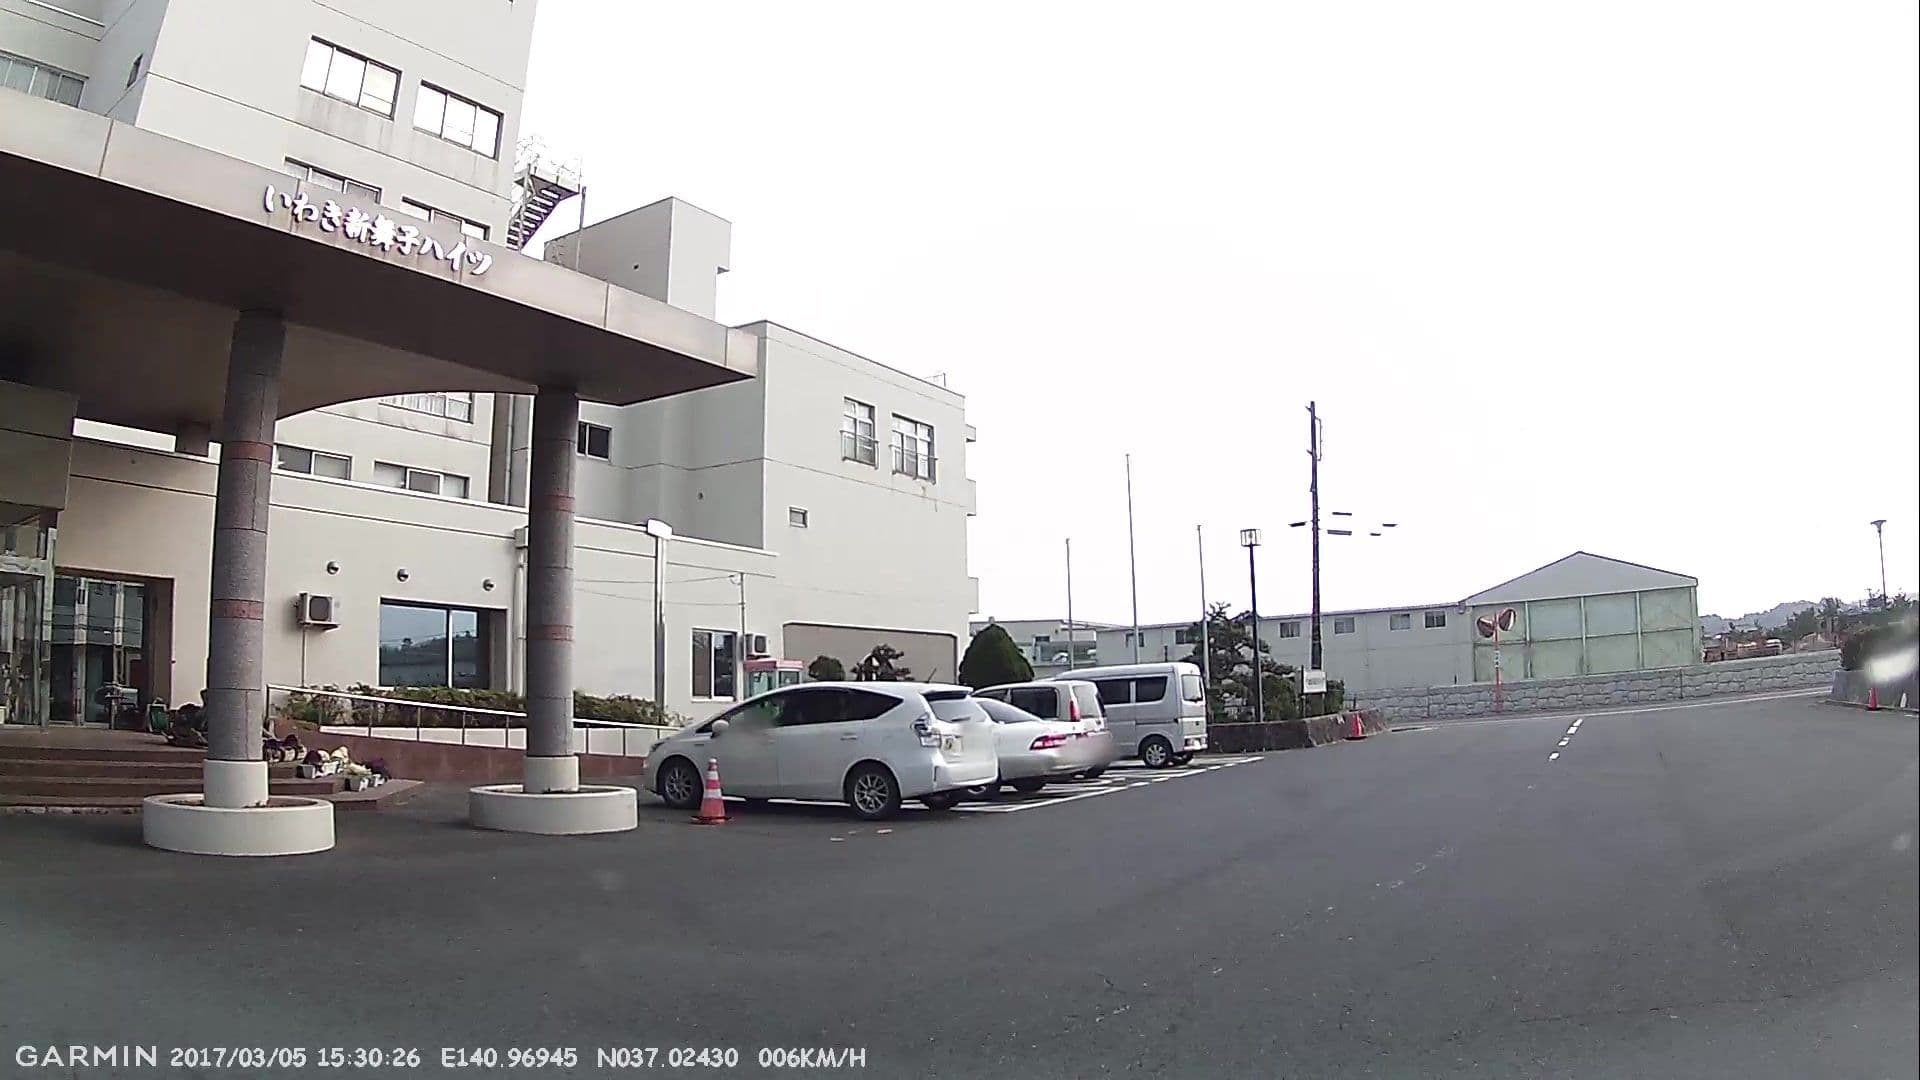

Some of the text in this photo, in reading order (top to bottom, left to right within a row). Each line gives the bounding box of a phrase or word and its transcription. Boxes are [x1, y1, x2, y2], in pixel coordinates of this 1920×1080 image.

[263, 184, 493, 275] いわき新舞子ハイツ
